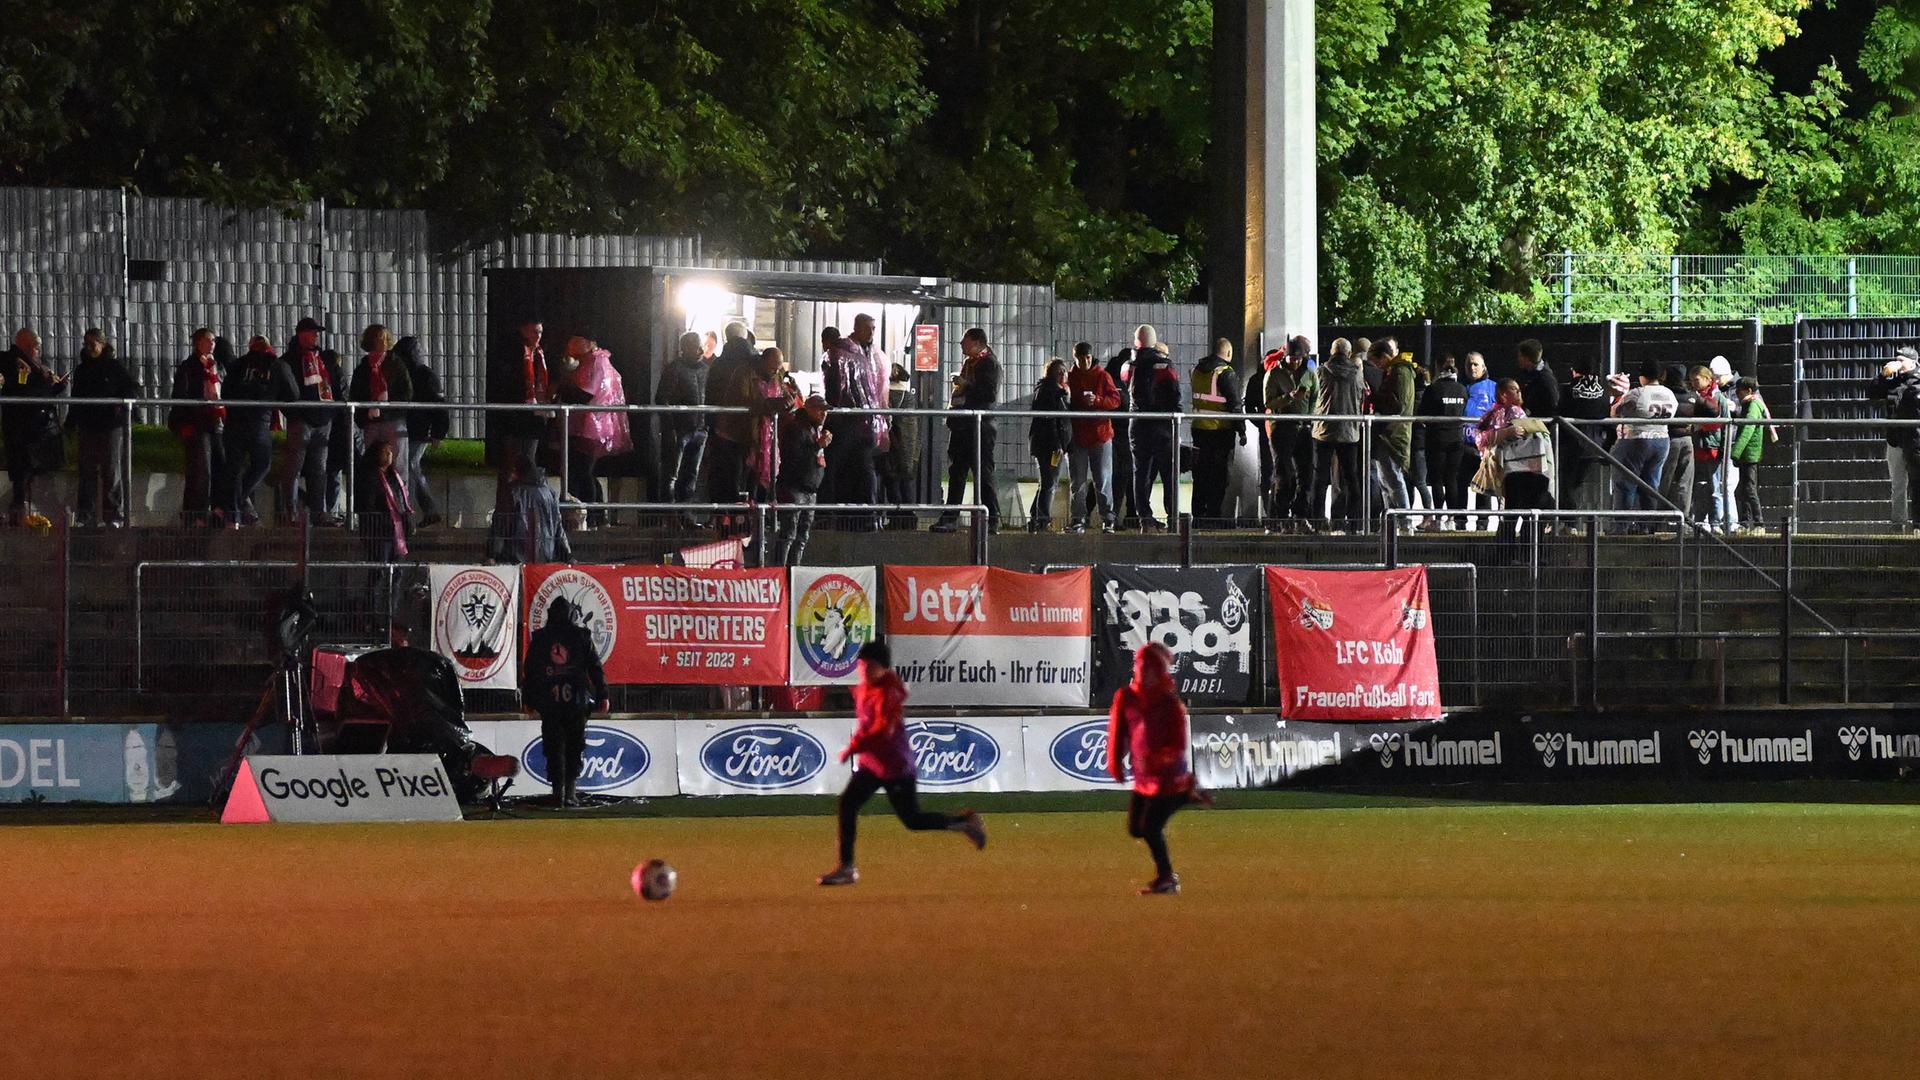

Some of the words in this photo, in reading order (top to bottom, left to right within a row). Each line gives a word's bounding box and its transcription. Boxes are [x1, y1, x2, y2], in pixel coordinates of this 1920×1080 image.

[1442, 397, 1457, 405] TEAM
[1457, 397, 1465, 405] FC
[580, 576, 614, 631] SUPPORTERS
[622, 574, 781, 604] GEISSBÖCKINNEN
[903, 576, 986, 622] Jetzt
[1009, 602, 1039, 622] und
[1042, 602, 1084, 622] immer
[645, 614, 766, 642] SUPPORTERS
[676, 651, 702, 667] SEIT
[705, 652, 736, 668] 2023
[1371, 638, 1405, 665] Köln
[895, 660, 926, 683] wir
[928, 659, 955, 684] für
[959, 660, 996, 684] Euch
[1011, 660, 1033, 683] Ihr
[1036, 659, 1058, 684] für
[1061, 661, 1087, 684] uns!
[1181, 678, 1226, 694] DABEI.
[552, 683, 573, 702] 16
[1296, 683, 1407, 709] Frauenfußball
[1409, 684, 1435, 706] Fans
[725, 734, 802, 777] Ford
[907, 732, 976, 773] Ford
[1243, 731, 1342, 766] hummel
[1405, 731, 1502, 766] hummel
[1566, 730, 1661, 766] hummel
[1720, 729, 1813, 763] hummel
[260, 767, 370, 808] Google
[375, 766, 449, 798] Pixel
